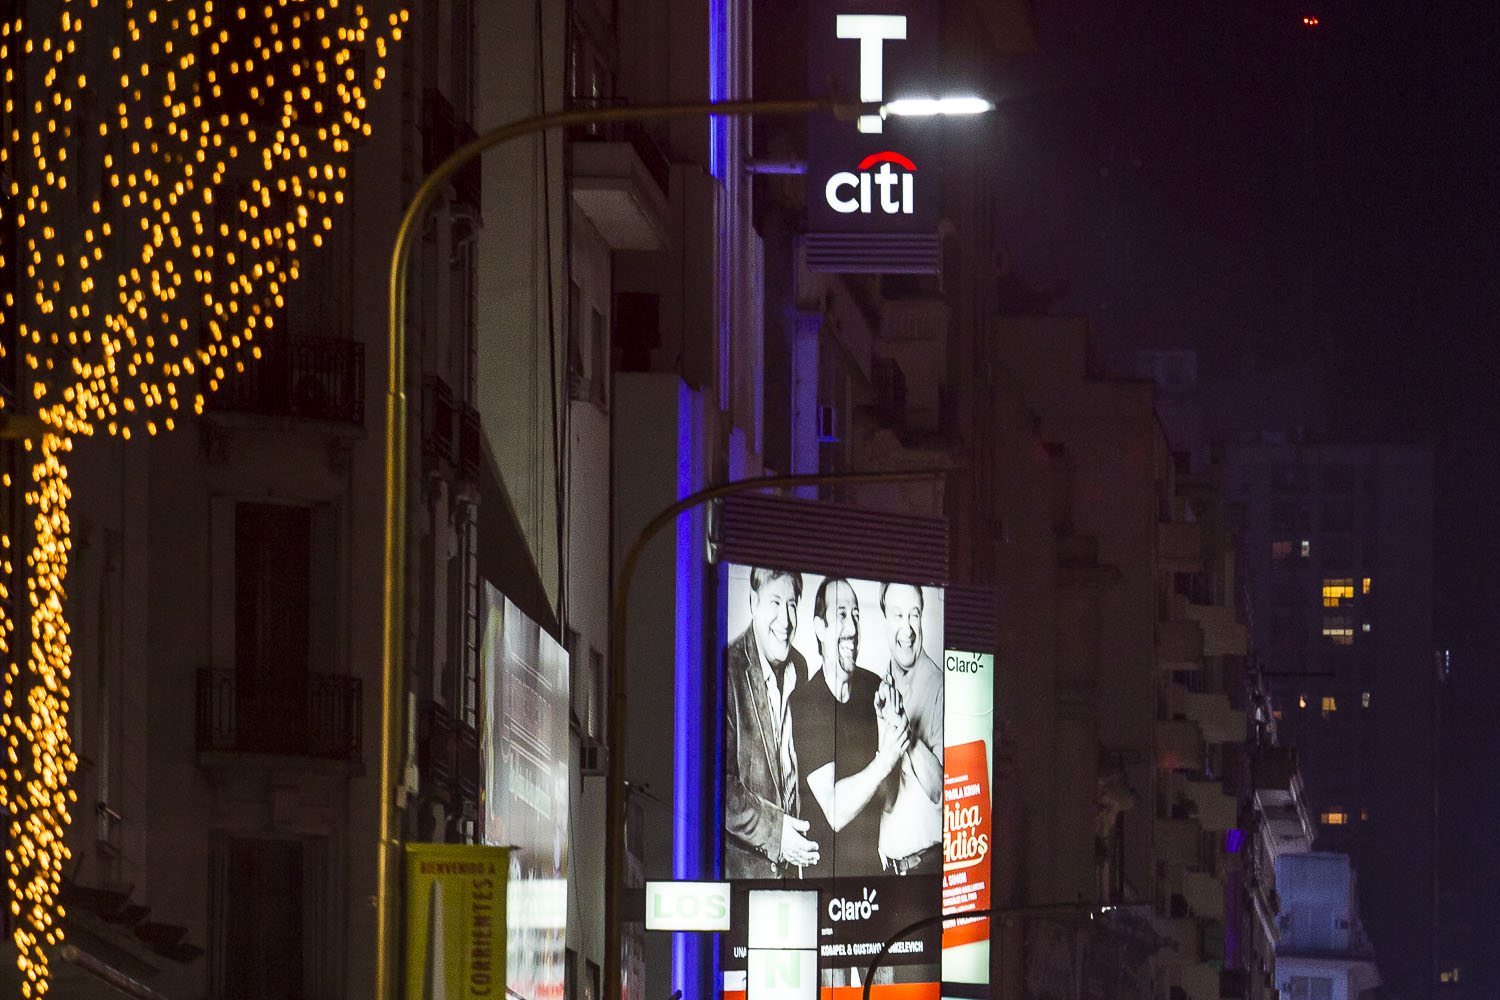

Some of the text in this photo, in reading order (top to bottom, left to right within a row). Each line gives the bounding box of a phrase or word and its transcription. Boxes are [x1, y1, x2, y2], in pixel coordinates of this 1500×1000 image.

[825, 160, 917, 214] citi
[946, 655, 981, 673] Claro
[653, 893, 727, 919] LOS
[829, 892, 876, 922] Claro
[821, 944, 846, 957] KOMPEL
